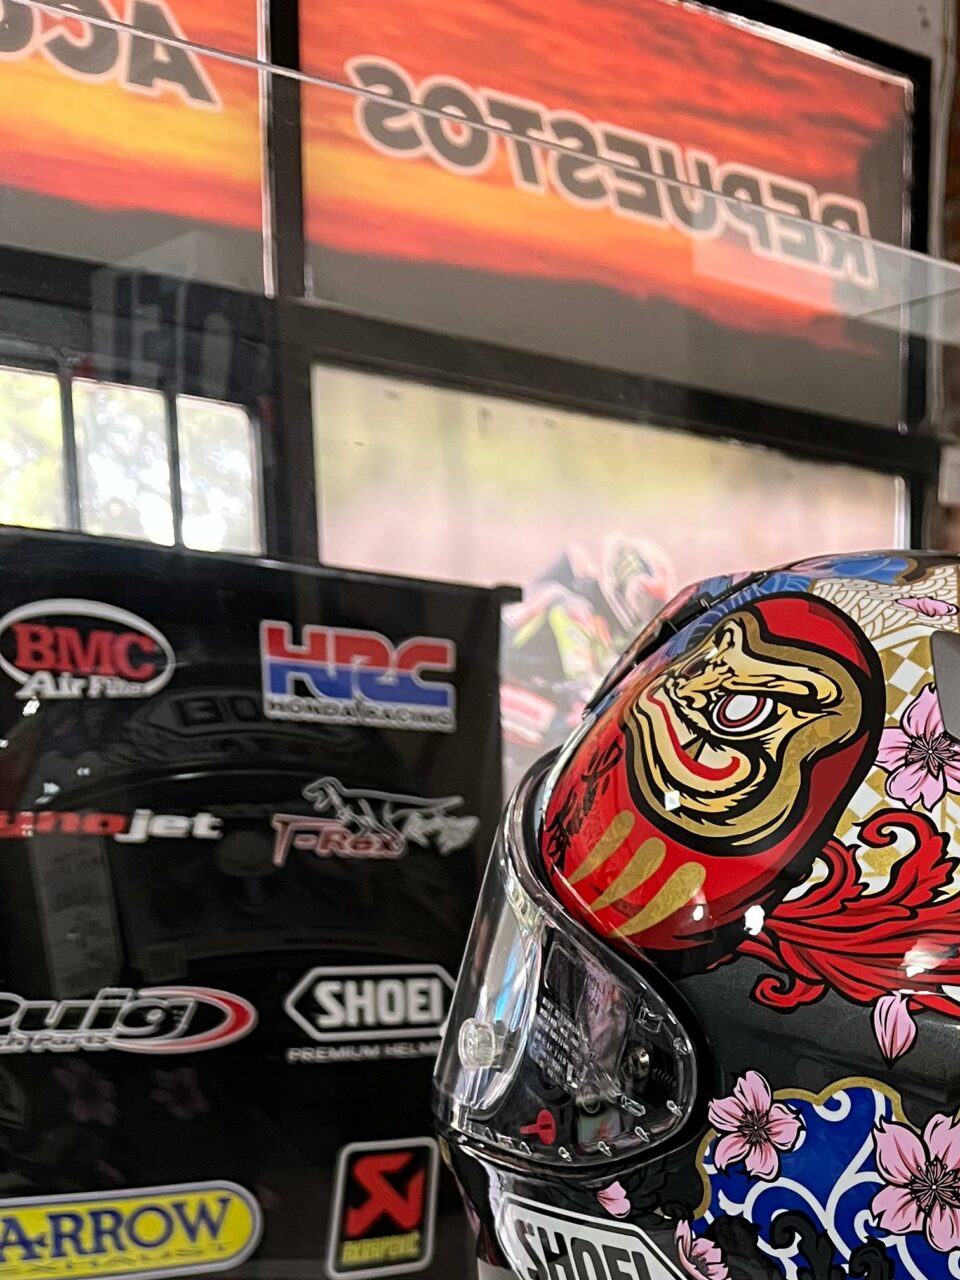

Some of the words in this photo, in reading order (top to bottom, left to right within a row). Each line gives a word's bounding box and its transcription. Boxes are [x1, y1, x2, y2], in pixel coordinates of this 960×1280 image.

[12, 622, 157, 682] BMC
[260, 620, 457, 708] HRC
[15, 671, 89, 699] Air
[313, 977, 444, 1029] SHOEI
[286, 1045, 381, 1064] PREMIUM
[0, 1198, 231, 1262] ARROW
